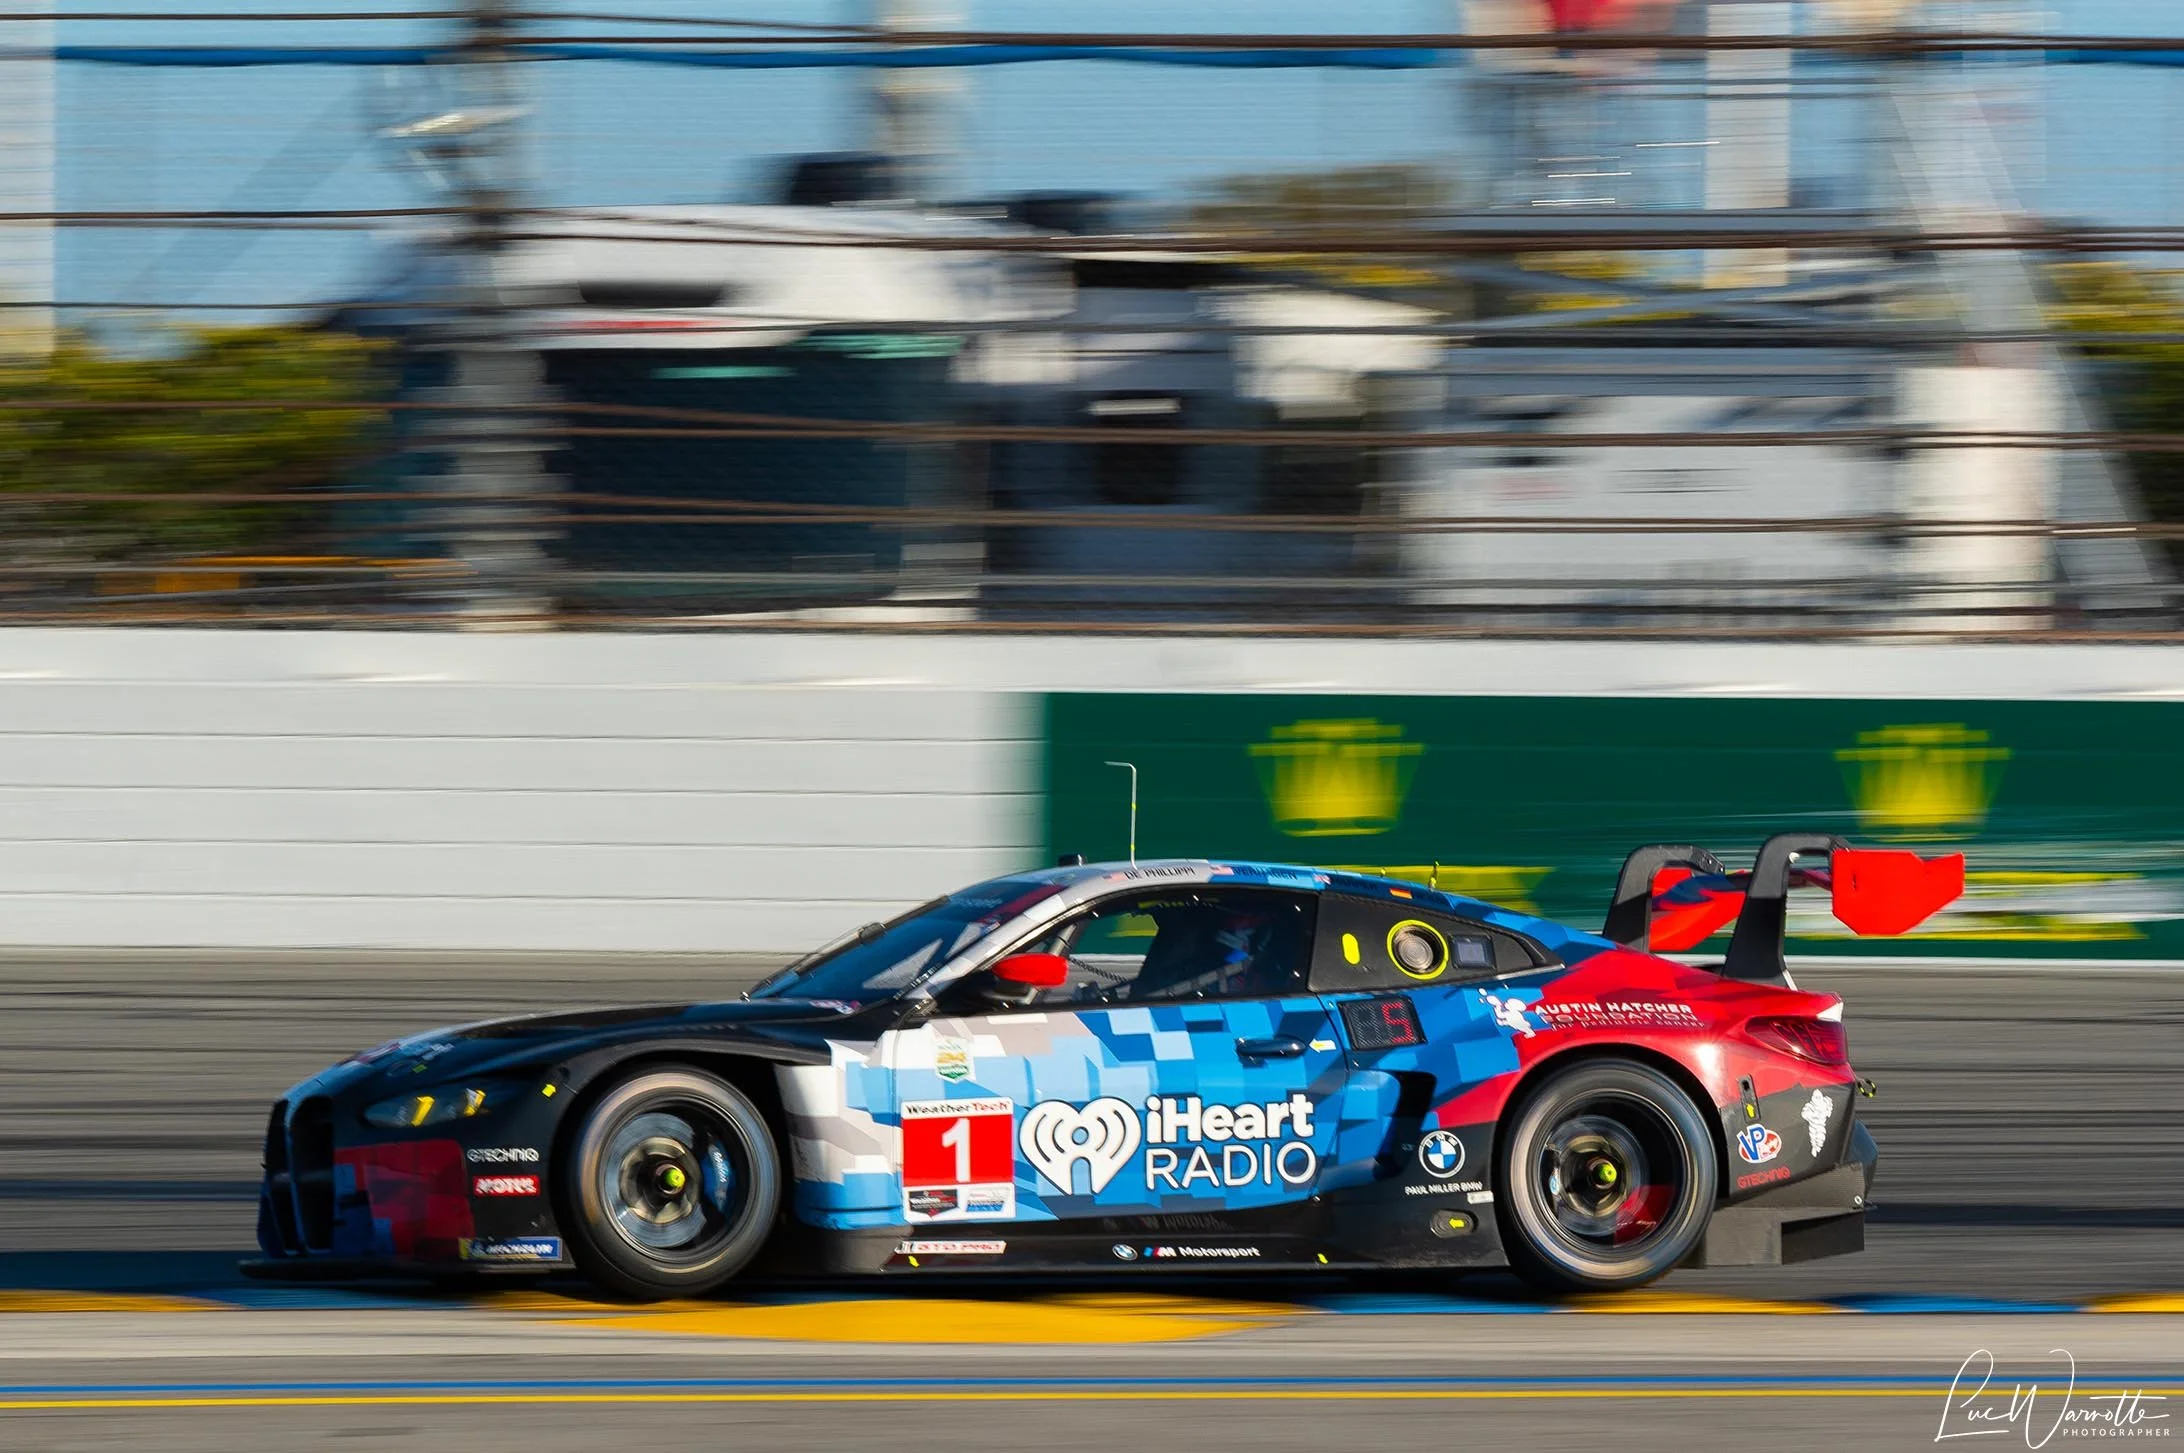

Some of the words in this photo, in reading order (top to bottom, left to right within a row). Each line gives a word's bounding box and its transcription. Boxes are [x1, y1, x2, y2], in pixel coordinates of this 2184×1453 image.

[1382, 1002, 1415, 1044] 5
[1535, 1002, 1603, 1015] AUSTIN
[1606, 1002, 1693, 1014] HATCHER
[1539, 1011, 1698, 1024] FOUNDATION
[1146, 1093, 1314, 1143] iHeart
[941, 1117, 971, 1183] 1
[1739, 1126, 1766, 1161] VP
[1145, 1141, 1317, 1190] RADIO
[1404, 1186, 1429, 1196] PAUL
[1428, 1183, 1460, 1194] MILLER
[1460, 1181, 1483, 1192] BMW
[1178, 1246, 1262, 1259] Motorsport
